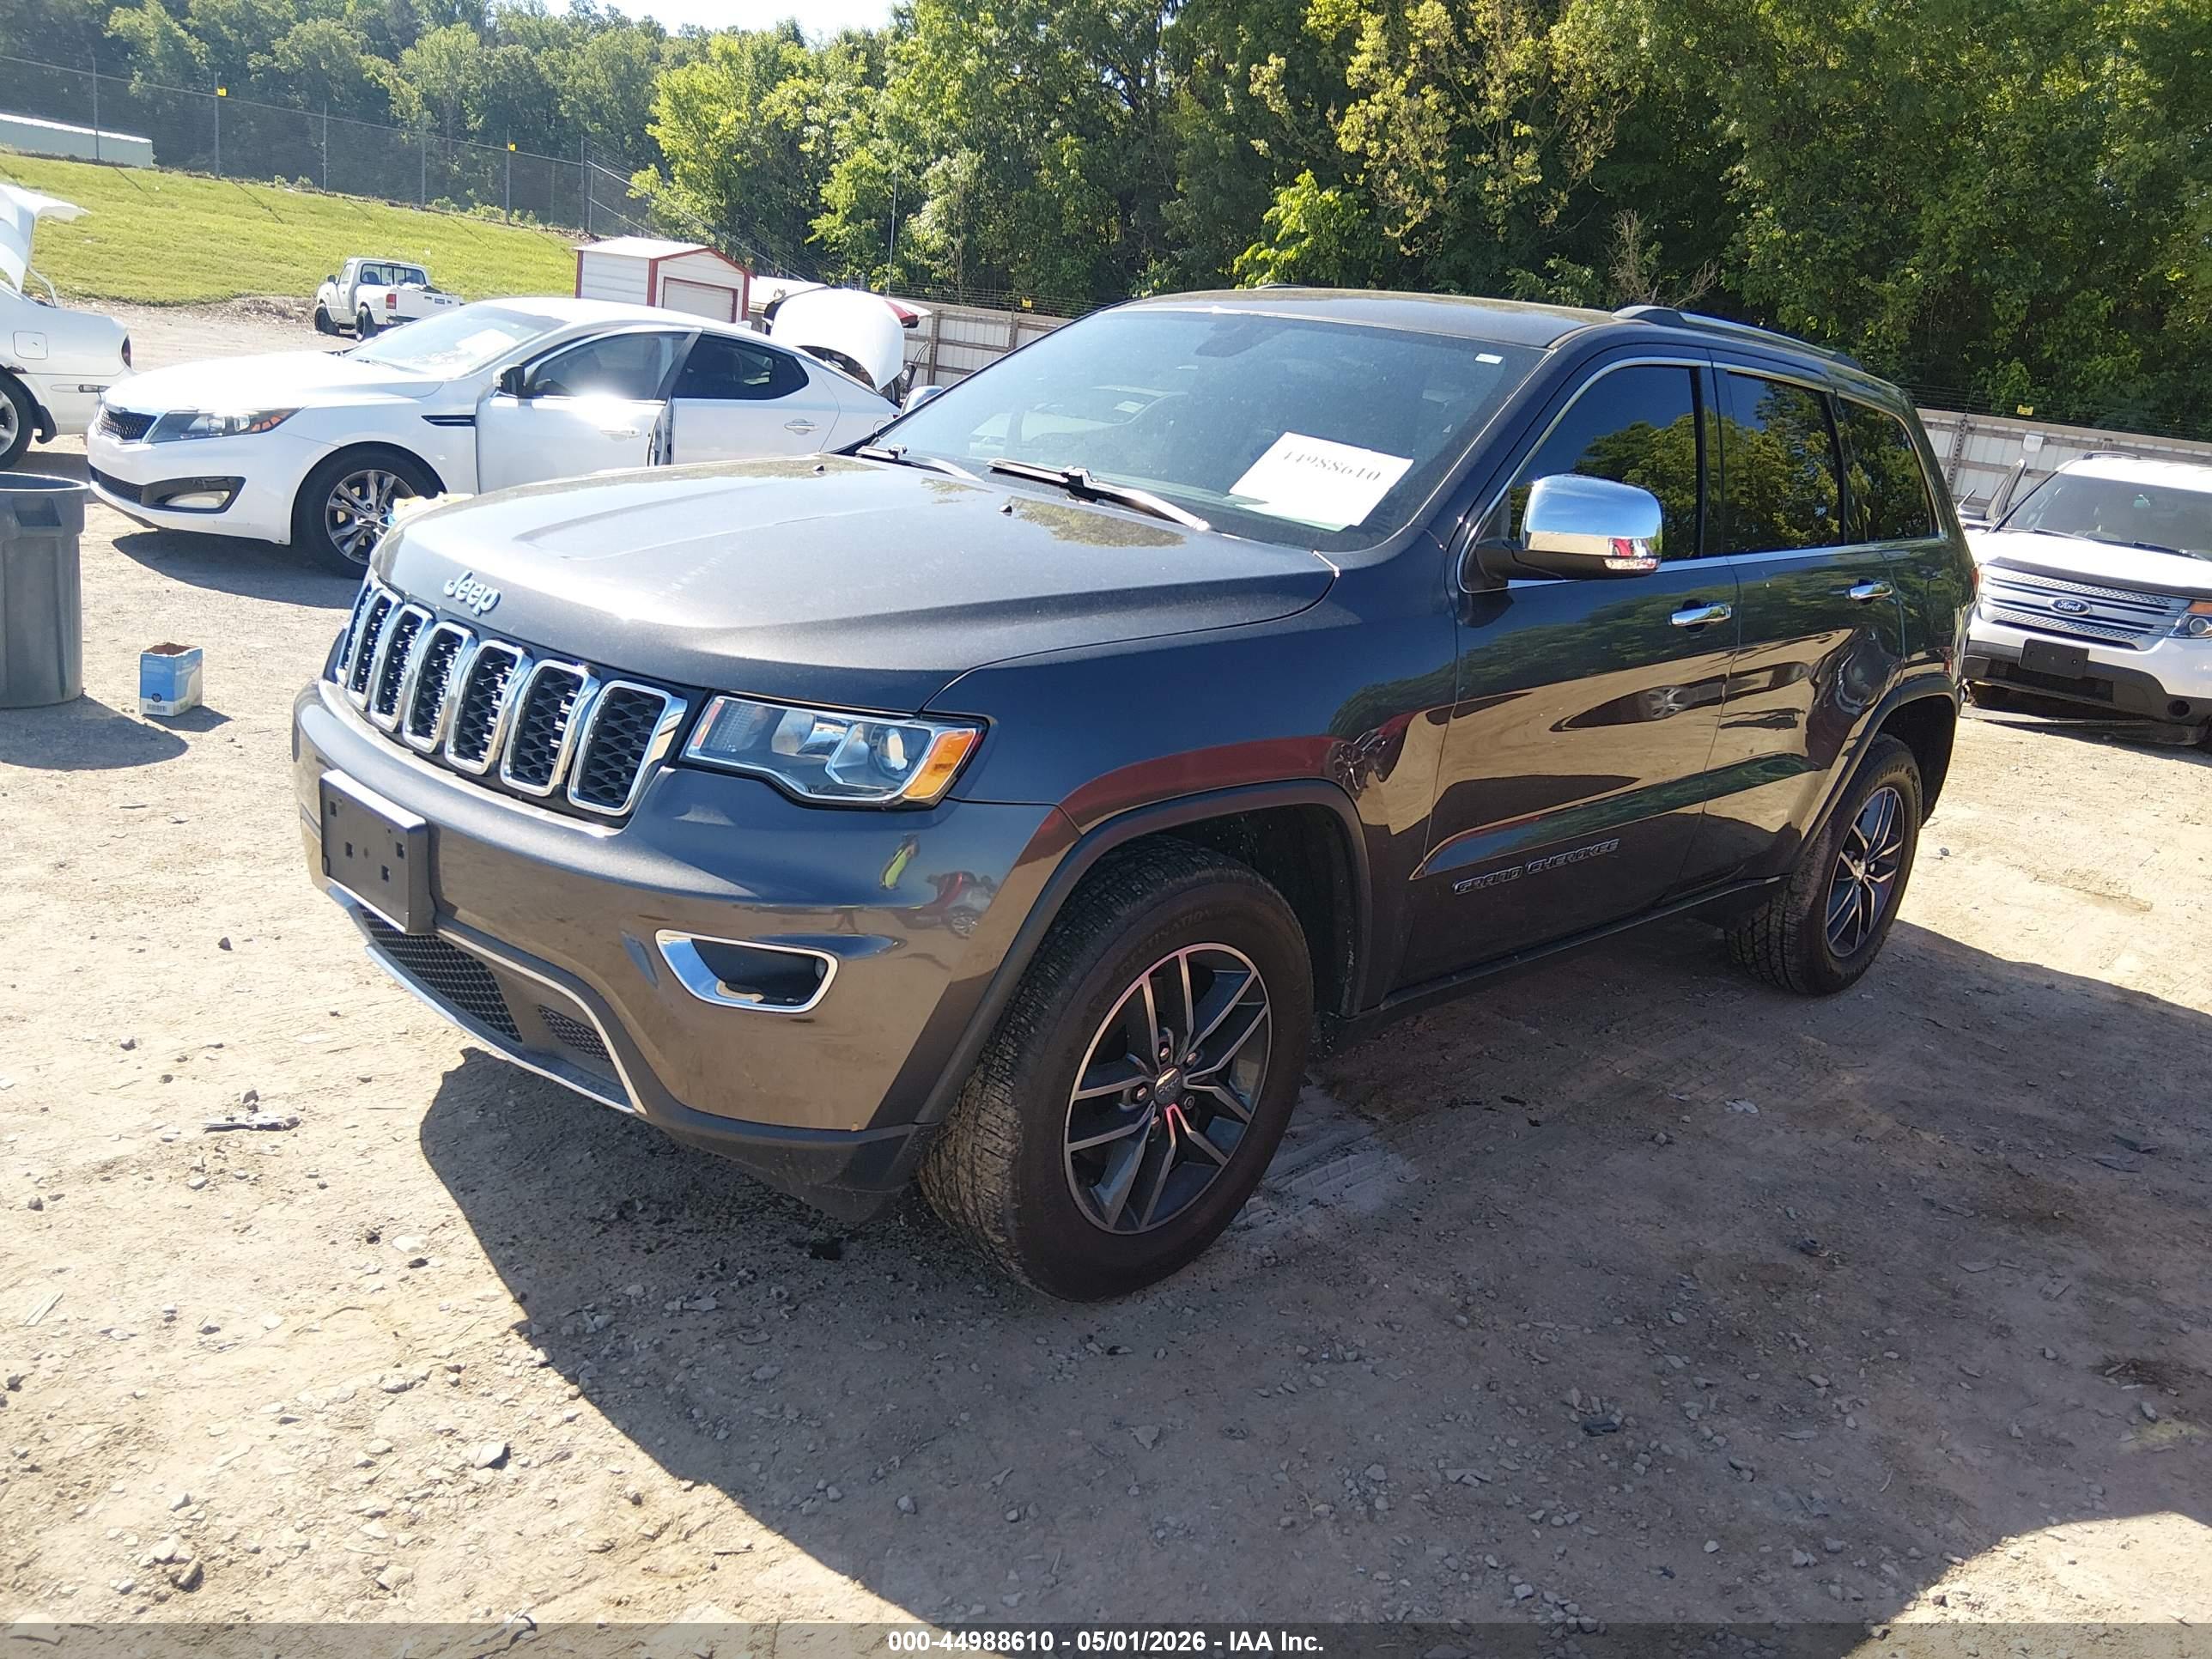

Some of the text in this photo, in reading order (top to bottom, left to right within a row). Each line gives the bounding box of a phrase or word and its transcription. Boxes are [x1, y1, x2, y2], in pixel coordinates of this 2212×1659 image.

[443, 569, 501, 616] Jeep
[1452, 838, 1620, 894] GRAND CHEROKEE
